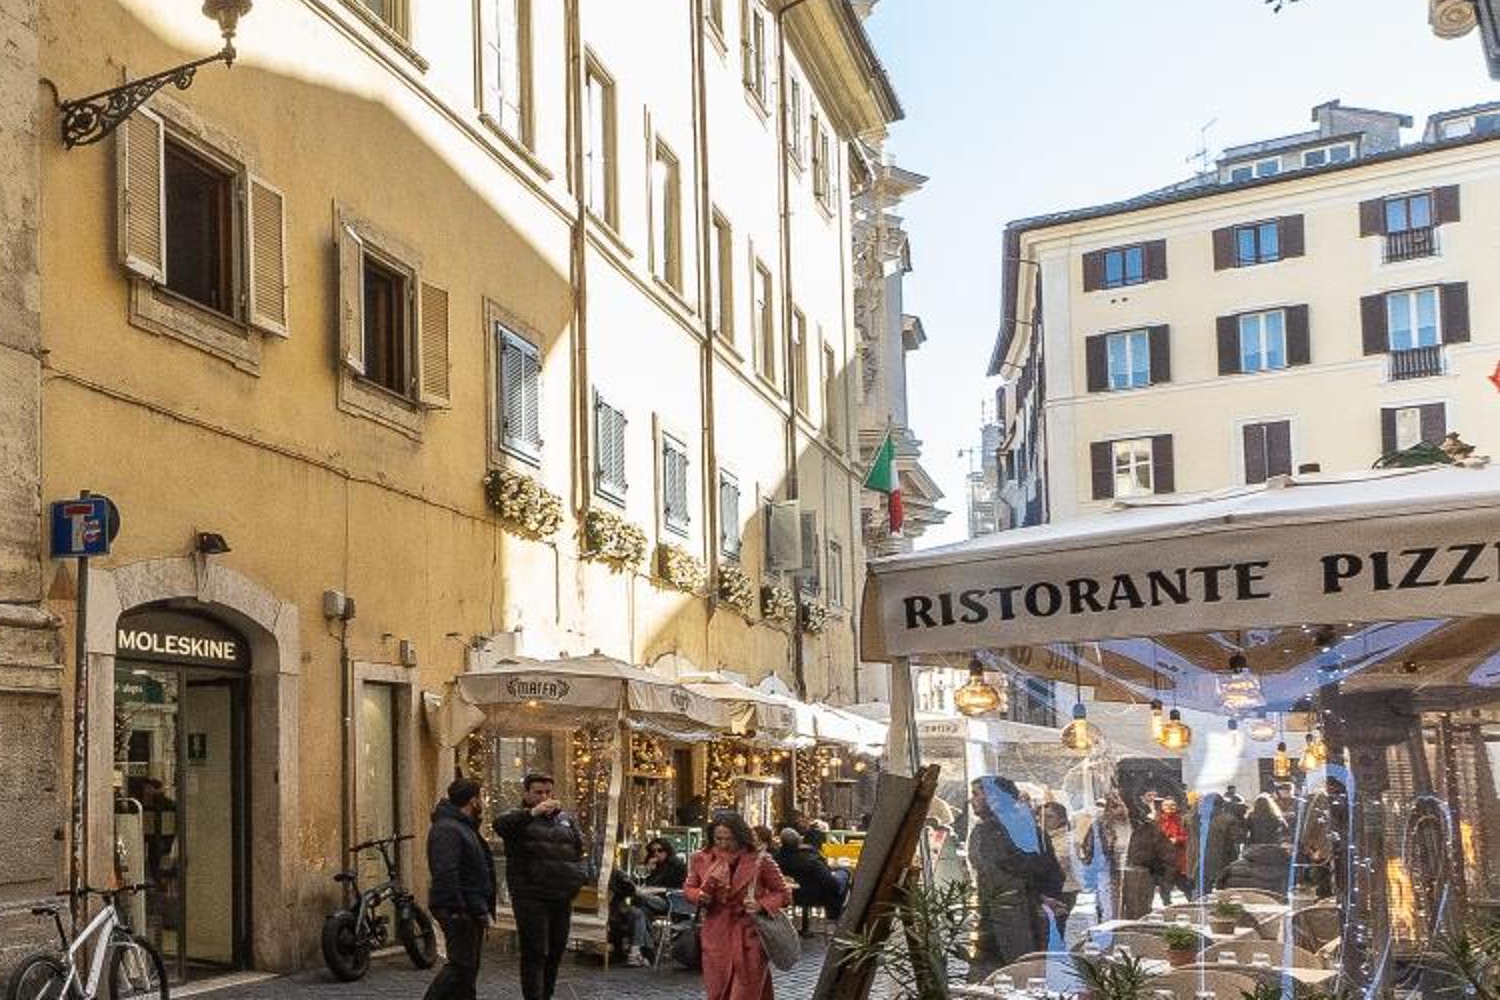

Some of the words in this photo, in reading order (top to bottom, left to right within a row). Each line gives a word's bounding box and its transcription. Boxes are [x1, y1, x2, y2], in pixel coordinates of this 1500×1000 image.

[903, 560, 1270, 629] RISTORANTE
[1321, 541, 1500, 594] PIZZ
[118, 630, 236, 660] MOLESKINE
